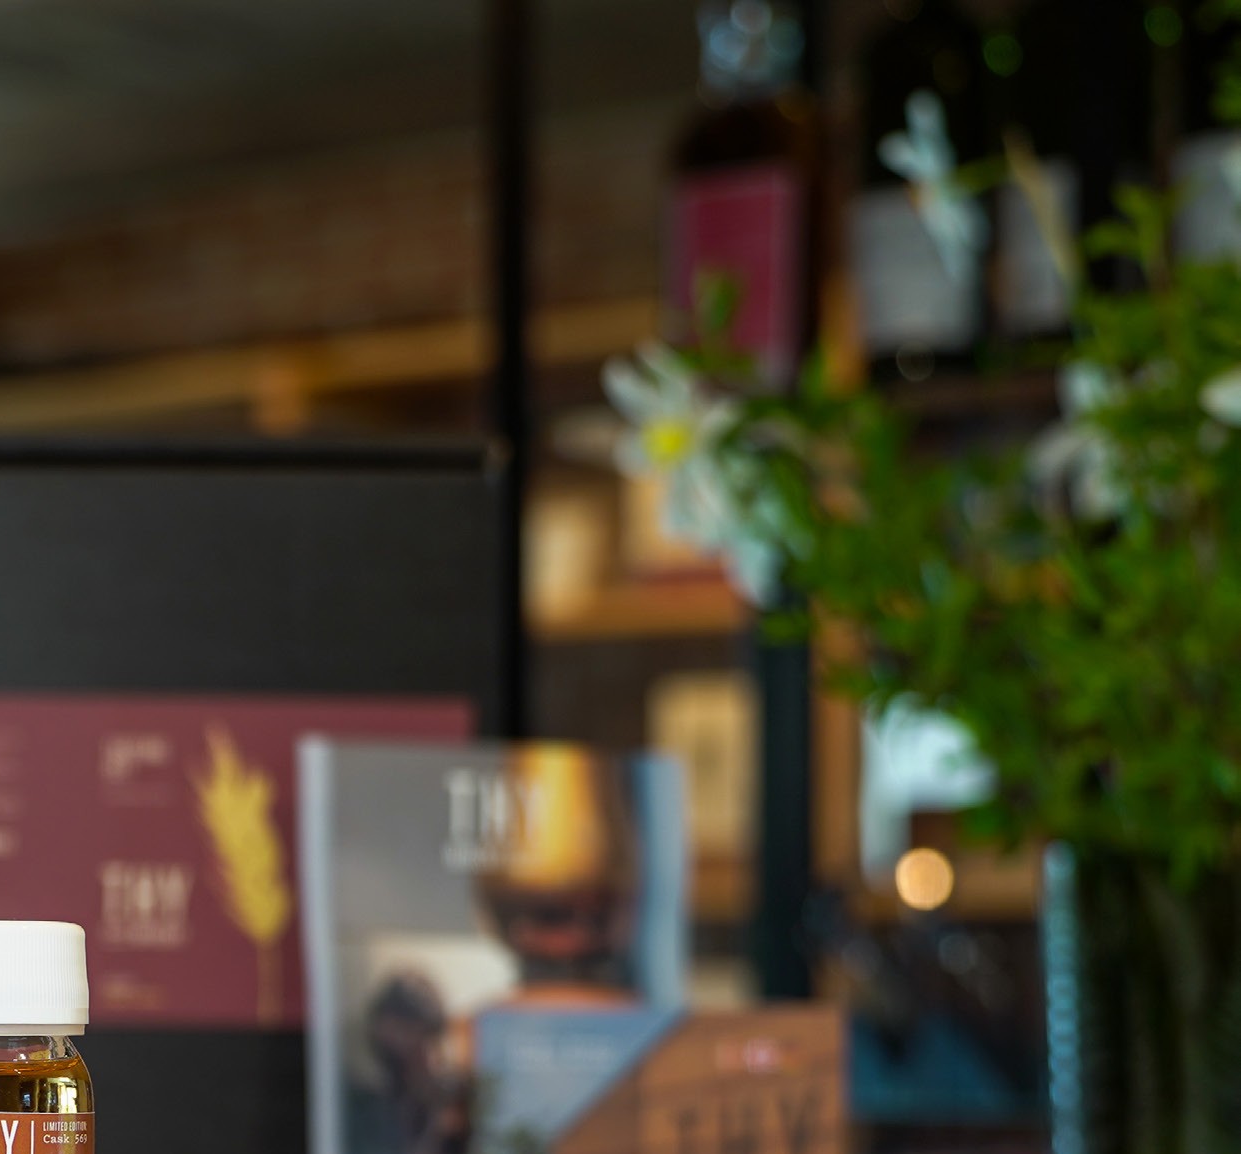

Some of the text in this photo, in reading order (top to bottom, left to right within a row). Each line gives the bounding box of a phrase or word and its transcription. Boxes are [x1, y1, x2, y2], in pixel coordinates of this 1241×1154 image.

[43, 1121, 68, 1132] LIMITED
[43, 1133, 88, 1145] Cask 569
